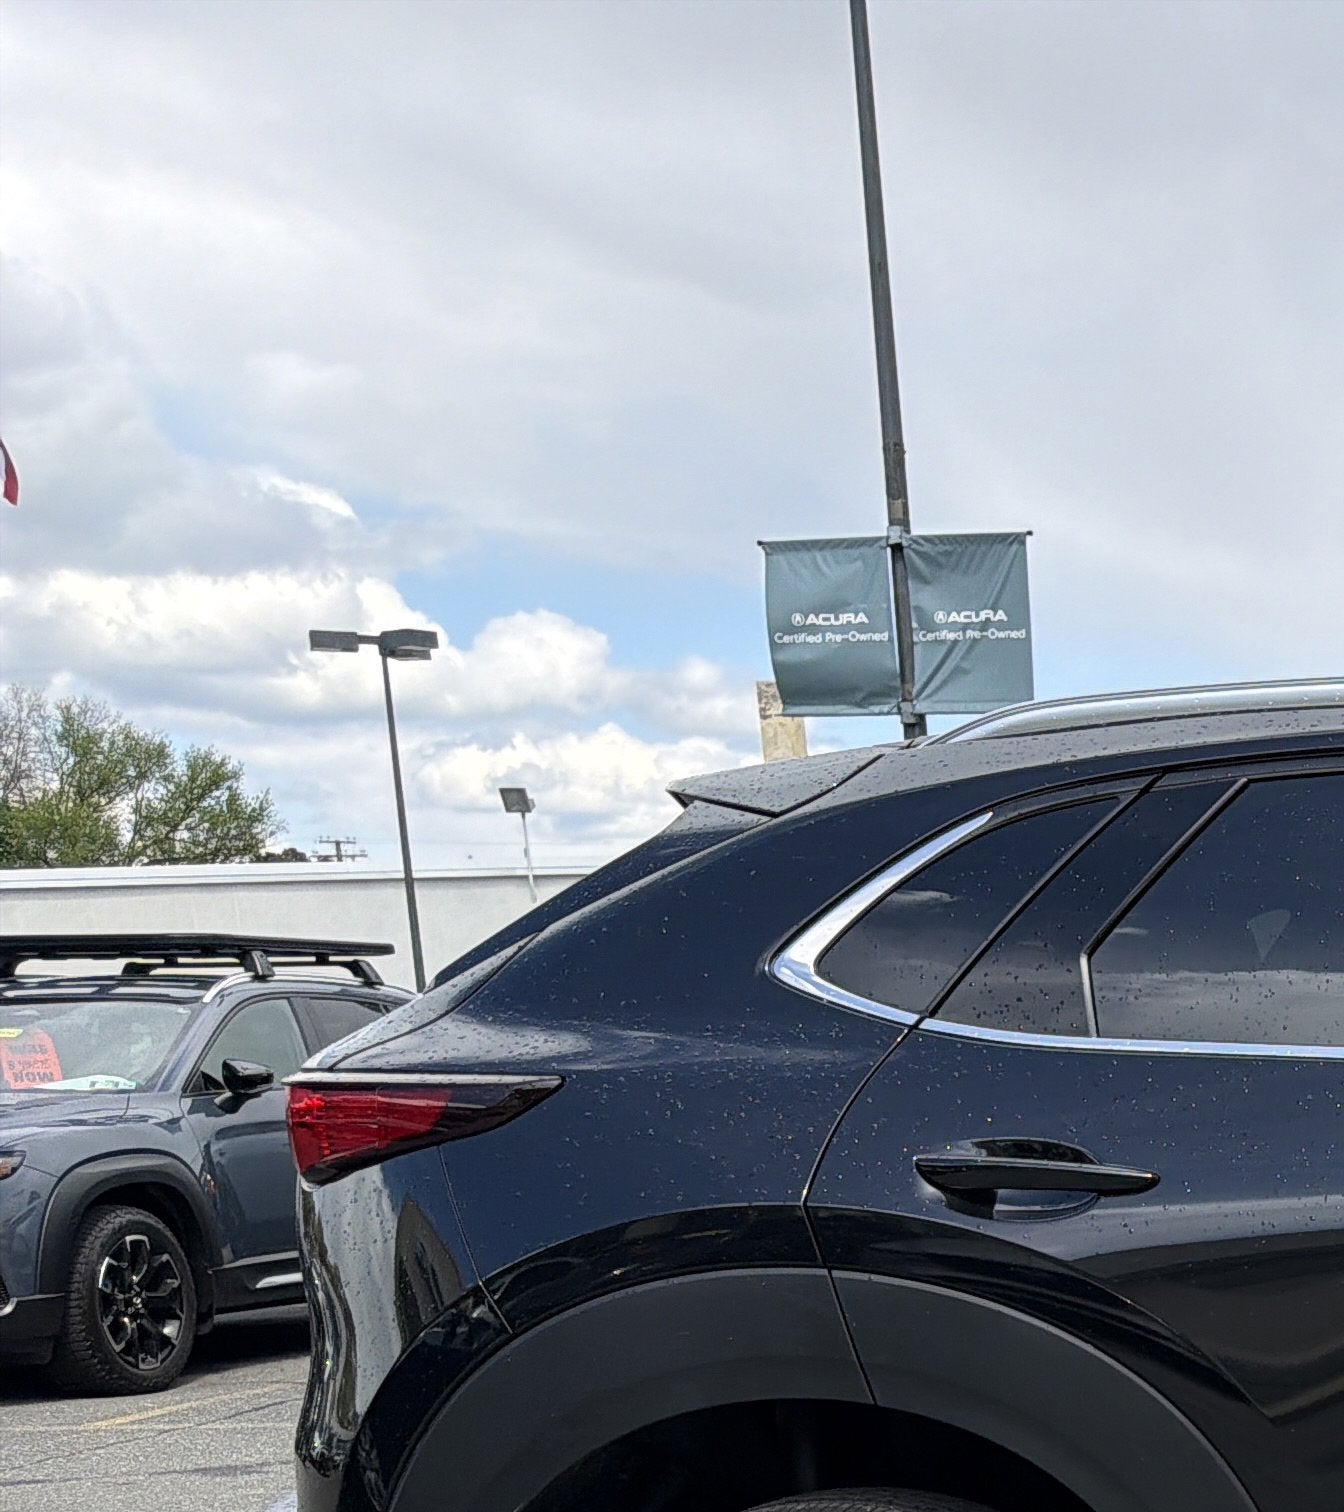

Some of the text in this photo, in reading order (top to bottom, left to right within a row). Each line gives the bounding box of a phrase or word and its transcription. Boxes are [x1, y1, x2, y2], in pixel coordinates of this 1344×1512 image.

[805, 612, 869, 626] ACURA
[948, 609, 1008, 623] ACURA
[774, 631, 888, 644] Certified Pre-Owned
[919, 628, 1026, 642] Certified Pre-Owned
